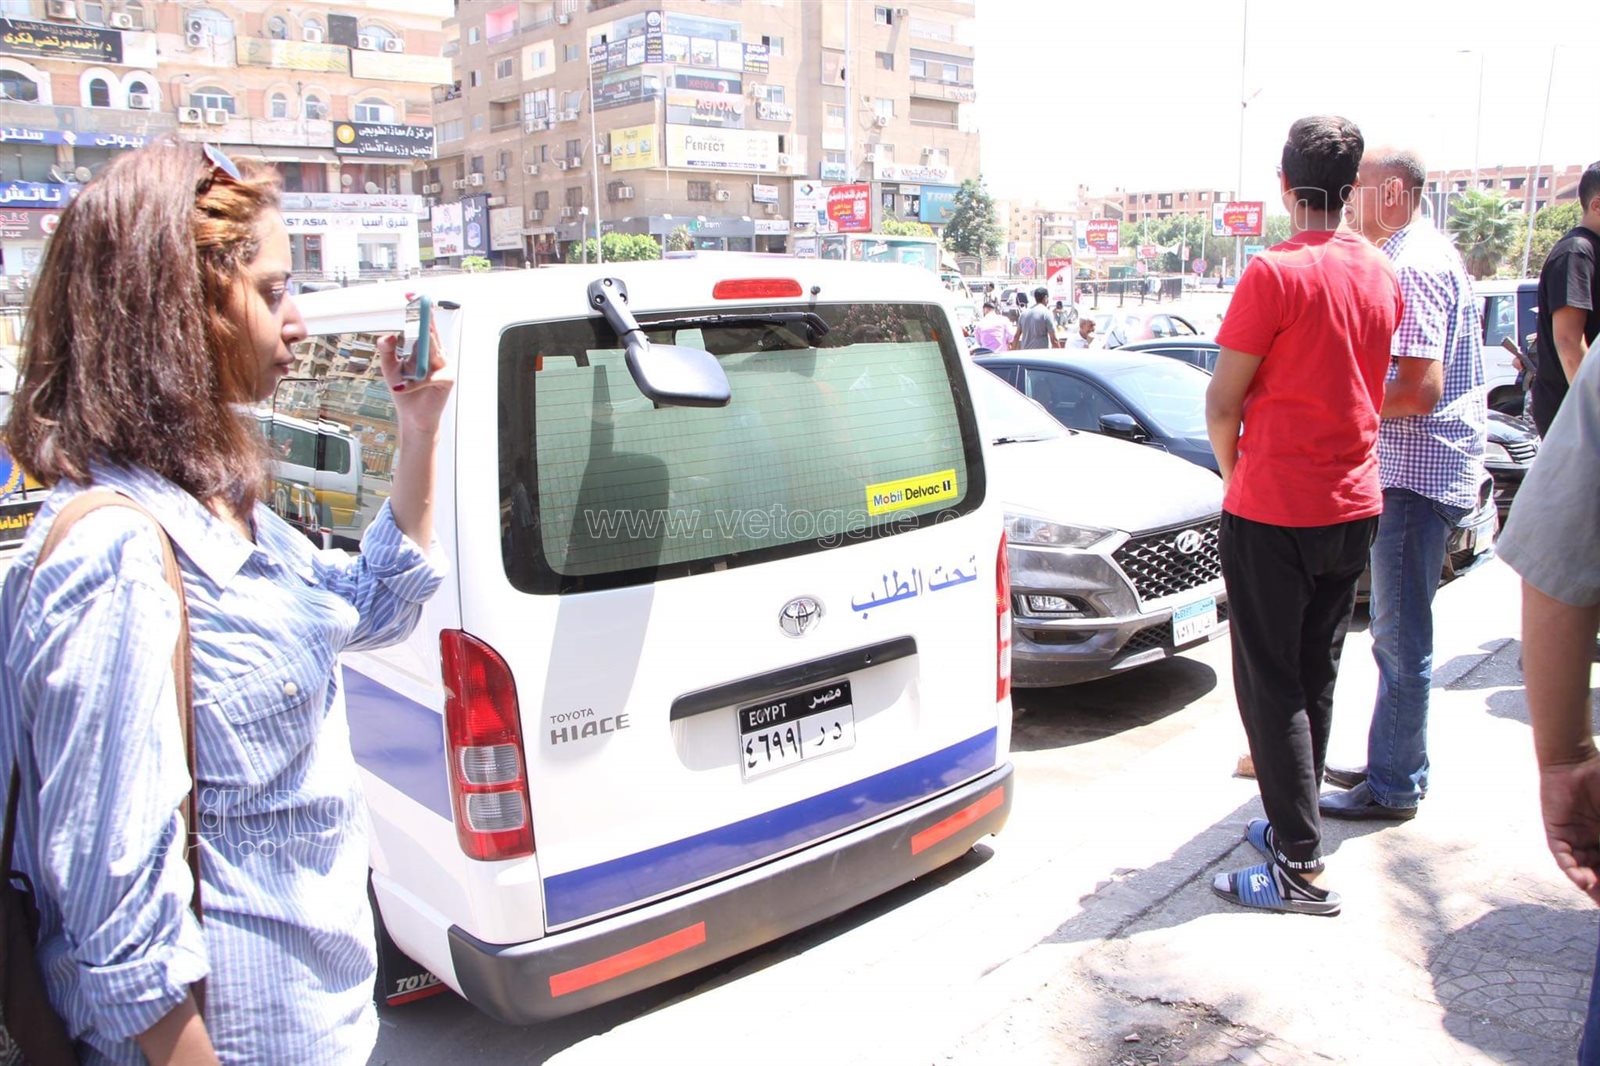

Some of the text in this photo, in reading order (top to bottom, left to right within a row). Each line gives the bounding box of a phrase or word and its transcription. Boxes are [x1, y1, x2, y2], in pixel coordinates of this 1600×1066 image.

[73, 39, 98, 50] أحمد
[414, 128, 433, 139] مركز
[302, 218, 329, 227] ASIA
[873, 489, 903, 507] Mobil
[905, 485, 941, 501] Delvac
[850, 554, 978, 620] تحت الطلب
[808, 687, 842, 709] مصر
[550, 707, 595, 724] TOYOTA
[748, 702, 788, 727] EGYPT
[550, 713, 631, 745] HIACE
[745, 727, 798, 769] ٤٦٩٩
